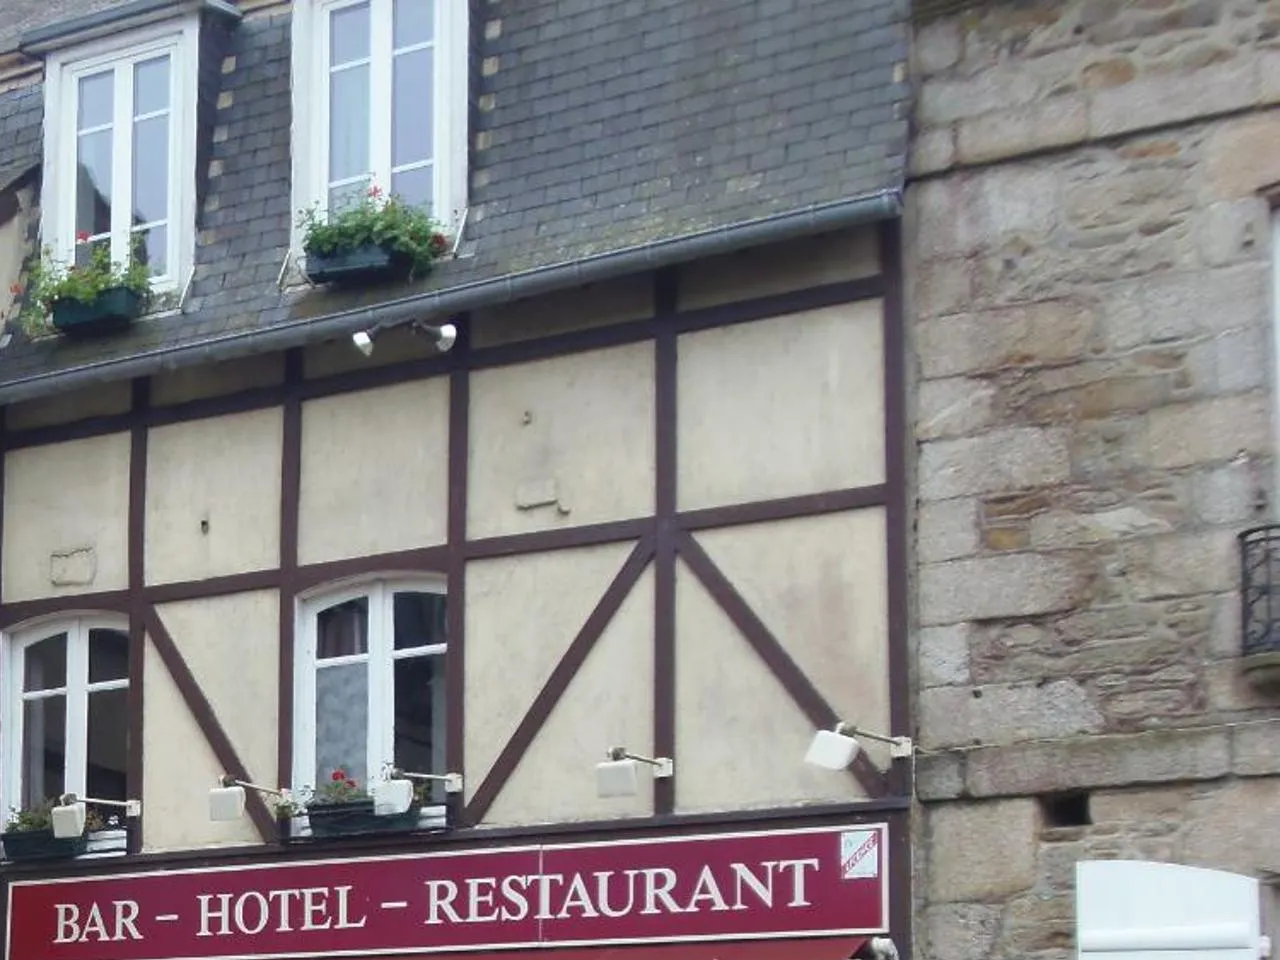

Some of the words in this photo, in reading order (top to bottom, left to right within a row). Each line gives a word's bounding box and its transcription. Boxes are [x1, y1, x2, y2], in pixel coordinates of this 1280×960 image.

[52, 900, 144, 944] BAR
[195, 884, 368, 938] HOTEL
[423, 857, 820, 926] RESTAURANT
